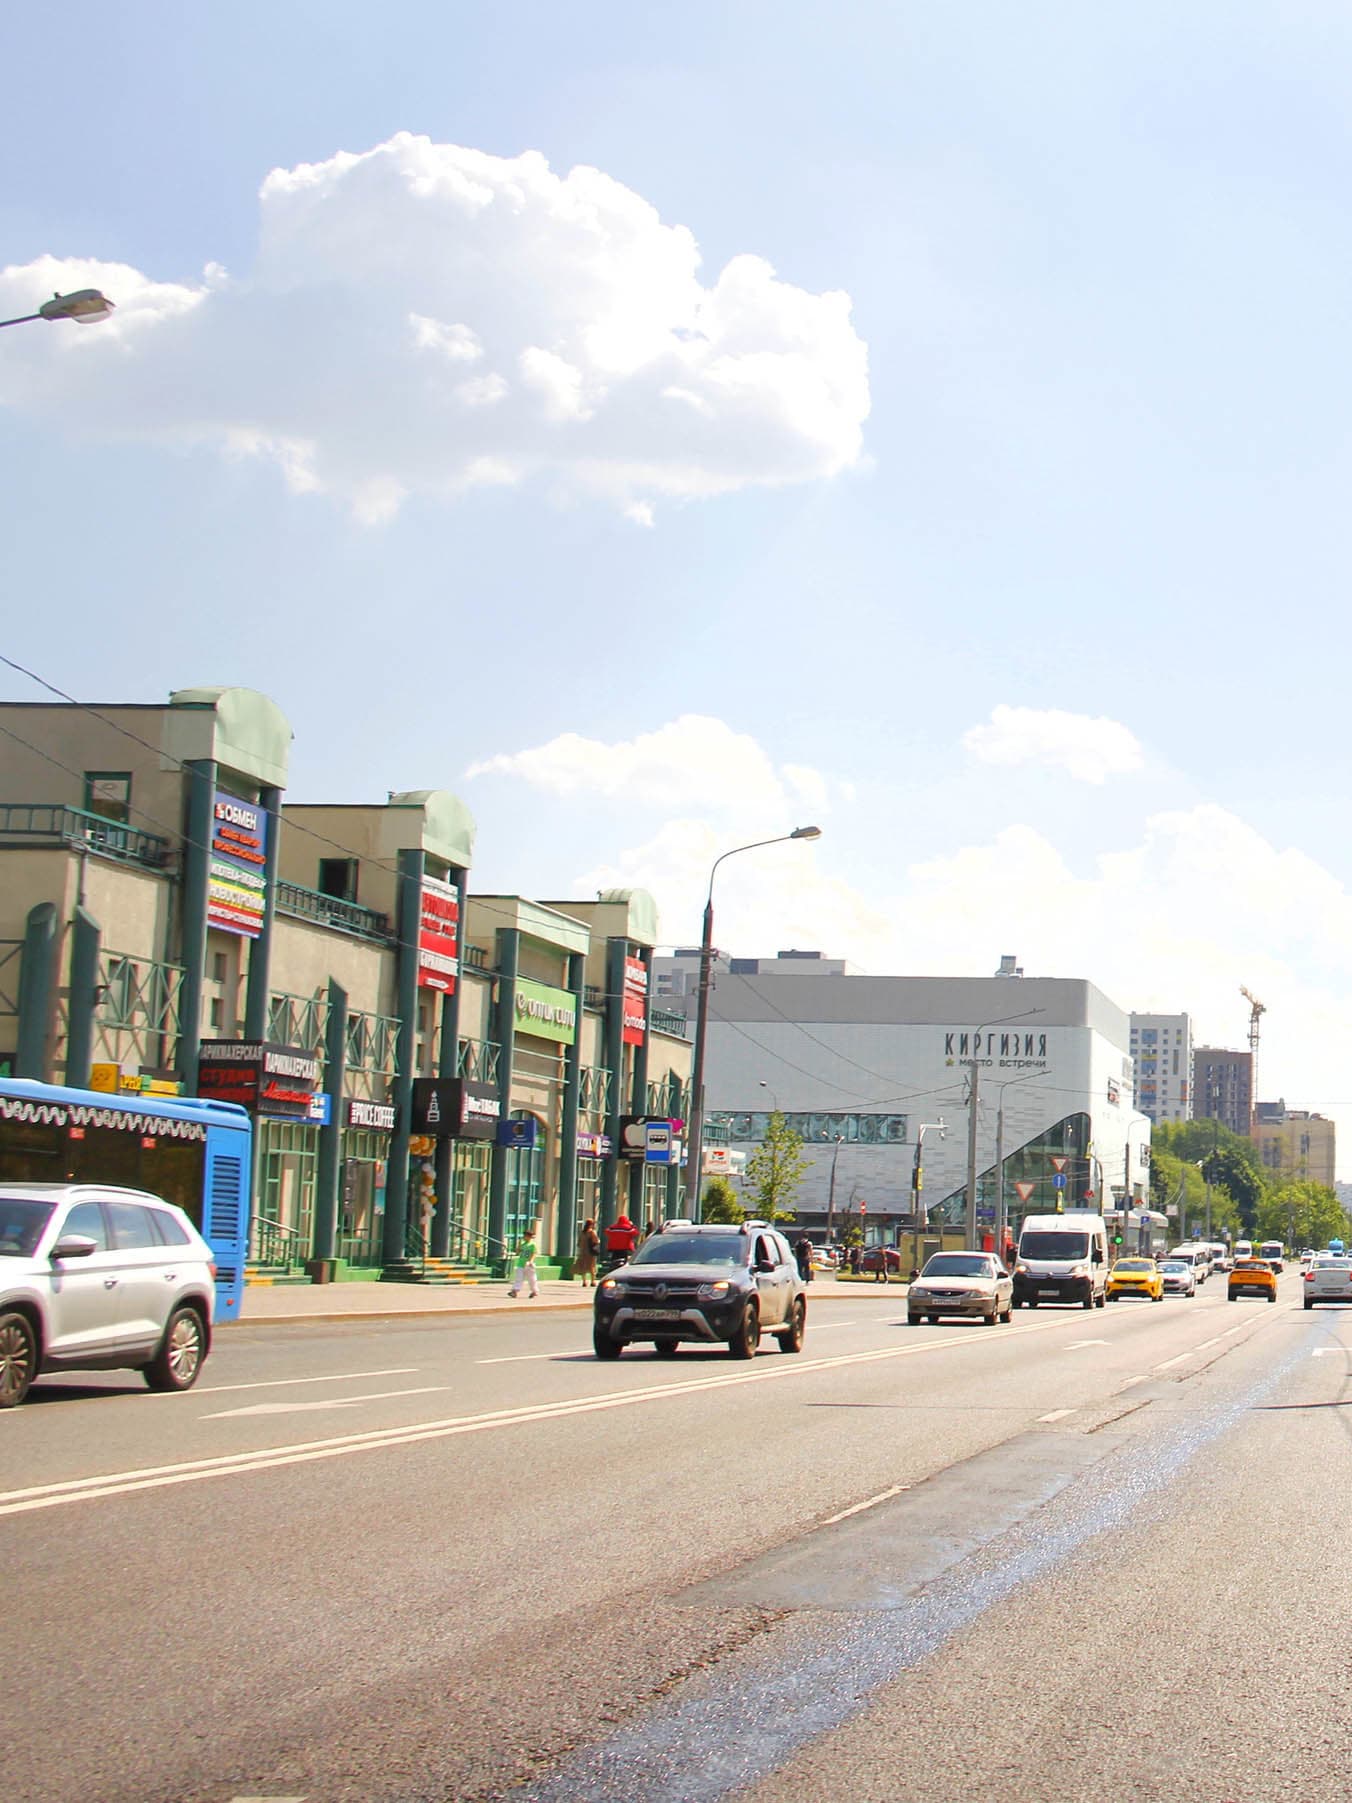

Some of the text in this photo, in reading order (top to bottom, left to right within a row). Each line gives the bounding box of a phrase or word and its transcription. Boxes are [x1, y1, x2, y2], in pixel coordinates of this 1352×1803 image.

[945, 1033, 1047, 1056] КИРГИЗИЯ
[959, 1059, 1047, 1068] место встречи
